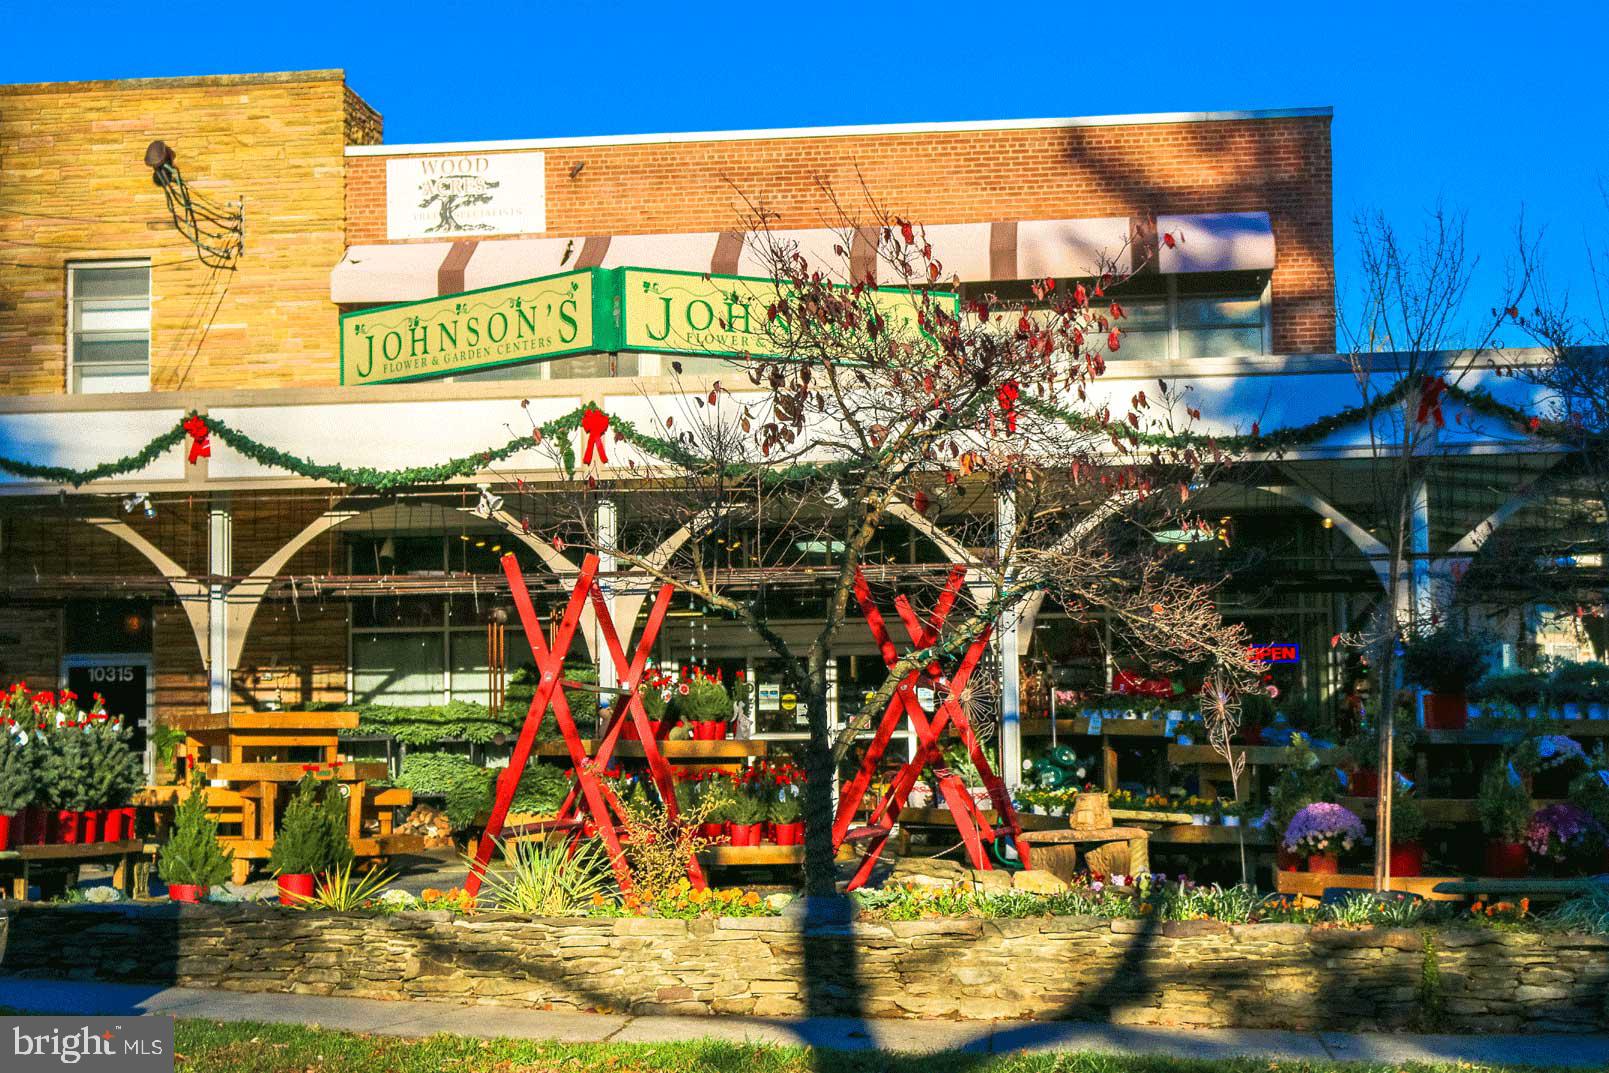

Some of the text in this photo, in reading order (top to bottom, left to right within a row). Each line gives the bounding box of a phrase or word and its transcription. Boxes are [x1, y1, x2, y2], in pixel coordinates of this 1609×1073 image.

[421, 157, 489, 175] WOOD
[422, 177, 487, 196] ACRES
[356, 299, 579, 378] JOHNSON'S
[686, 332, 749, 347] FLOWER
[383, 336, 553, 374] FLOWER & GARDEN CENTERS
[88, 667, 134, 682] 10315
